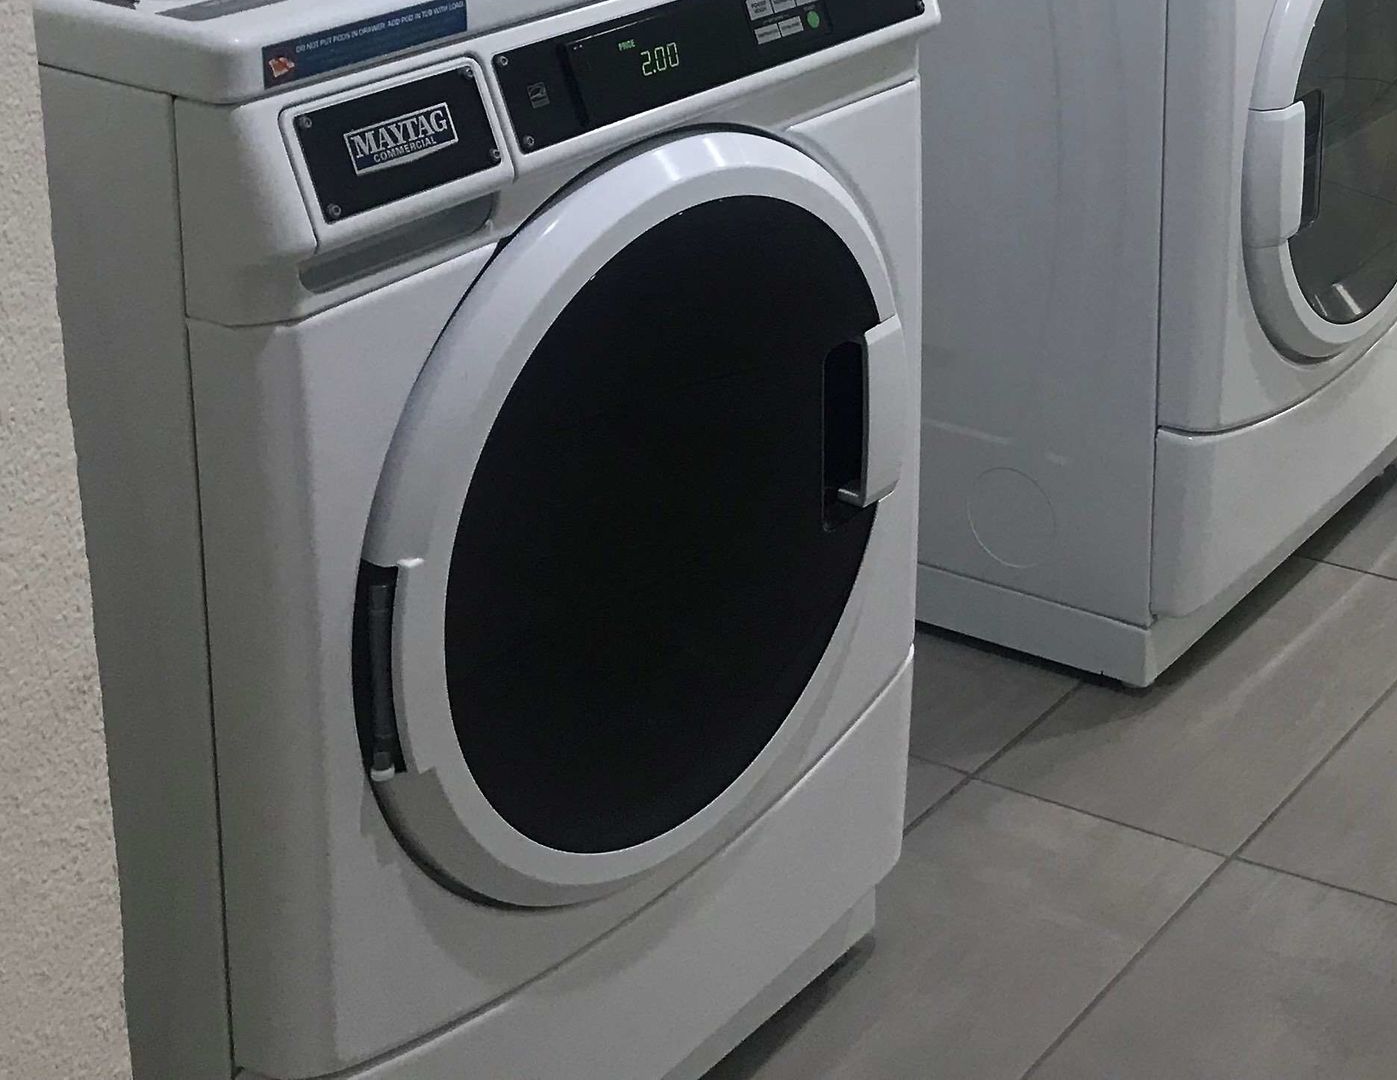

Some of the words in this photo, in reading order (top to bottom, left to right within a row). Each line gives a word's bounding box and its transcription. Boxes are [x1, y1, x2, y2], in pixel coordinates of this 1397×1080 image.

[617, 39, 636, 52] PRICE
[640, 42, 679, 76] 2.00
[350, 110, 449, 159] MAYTAG
[373, 135, 437, 163] COMMERCIAL
